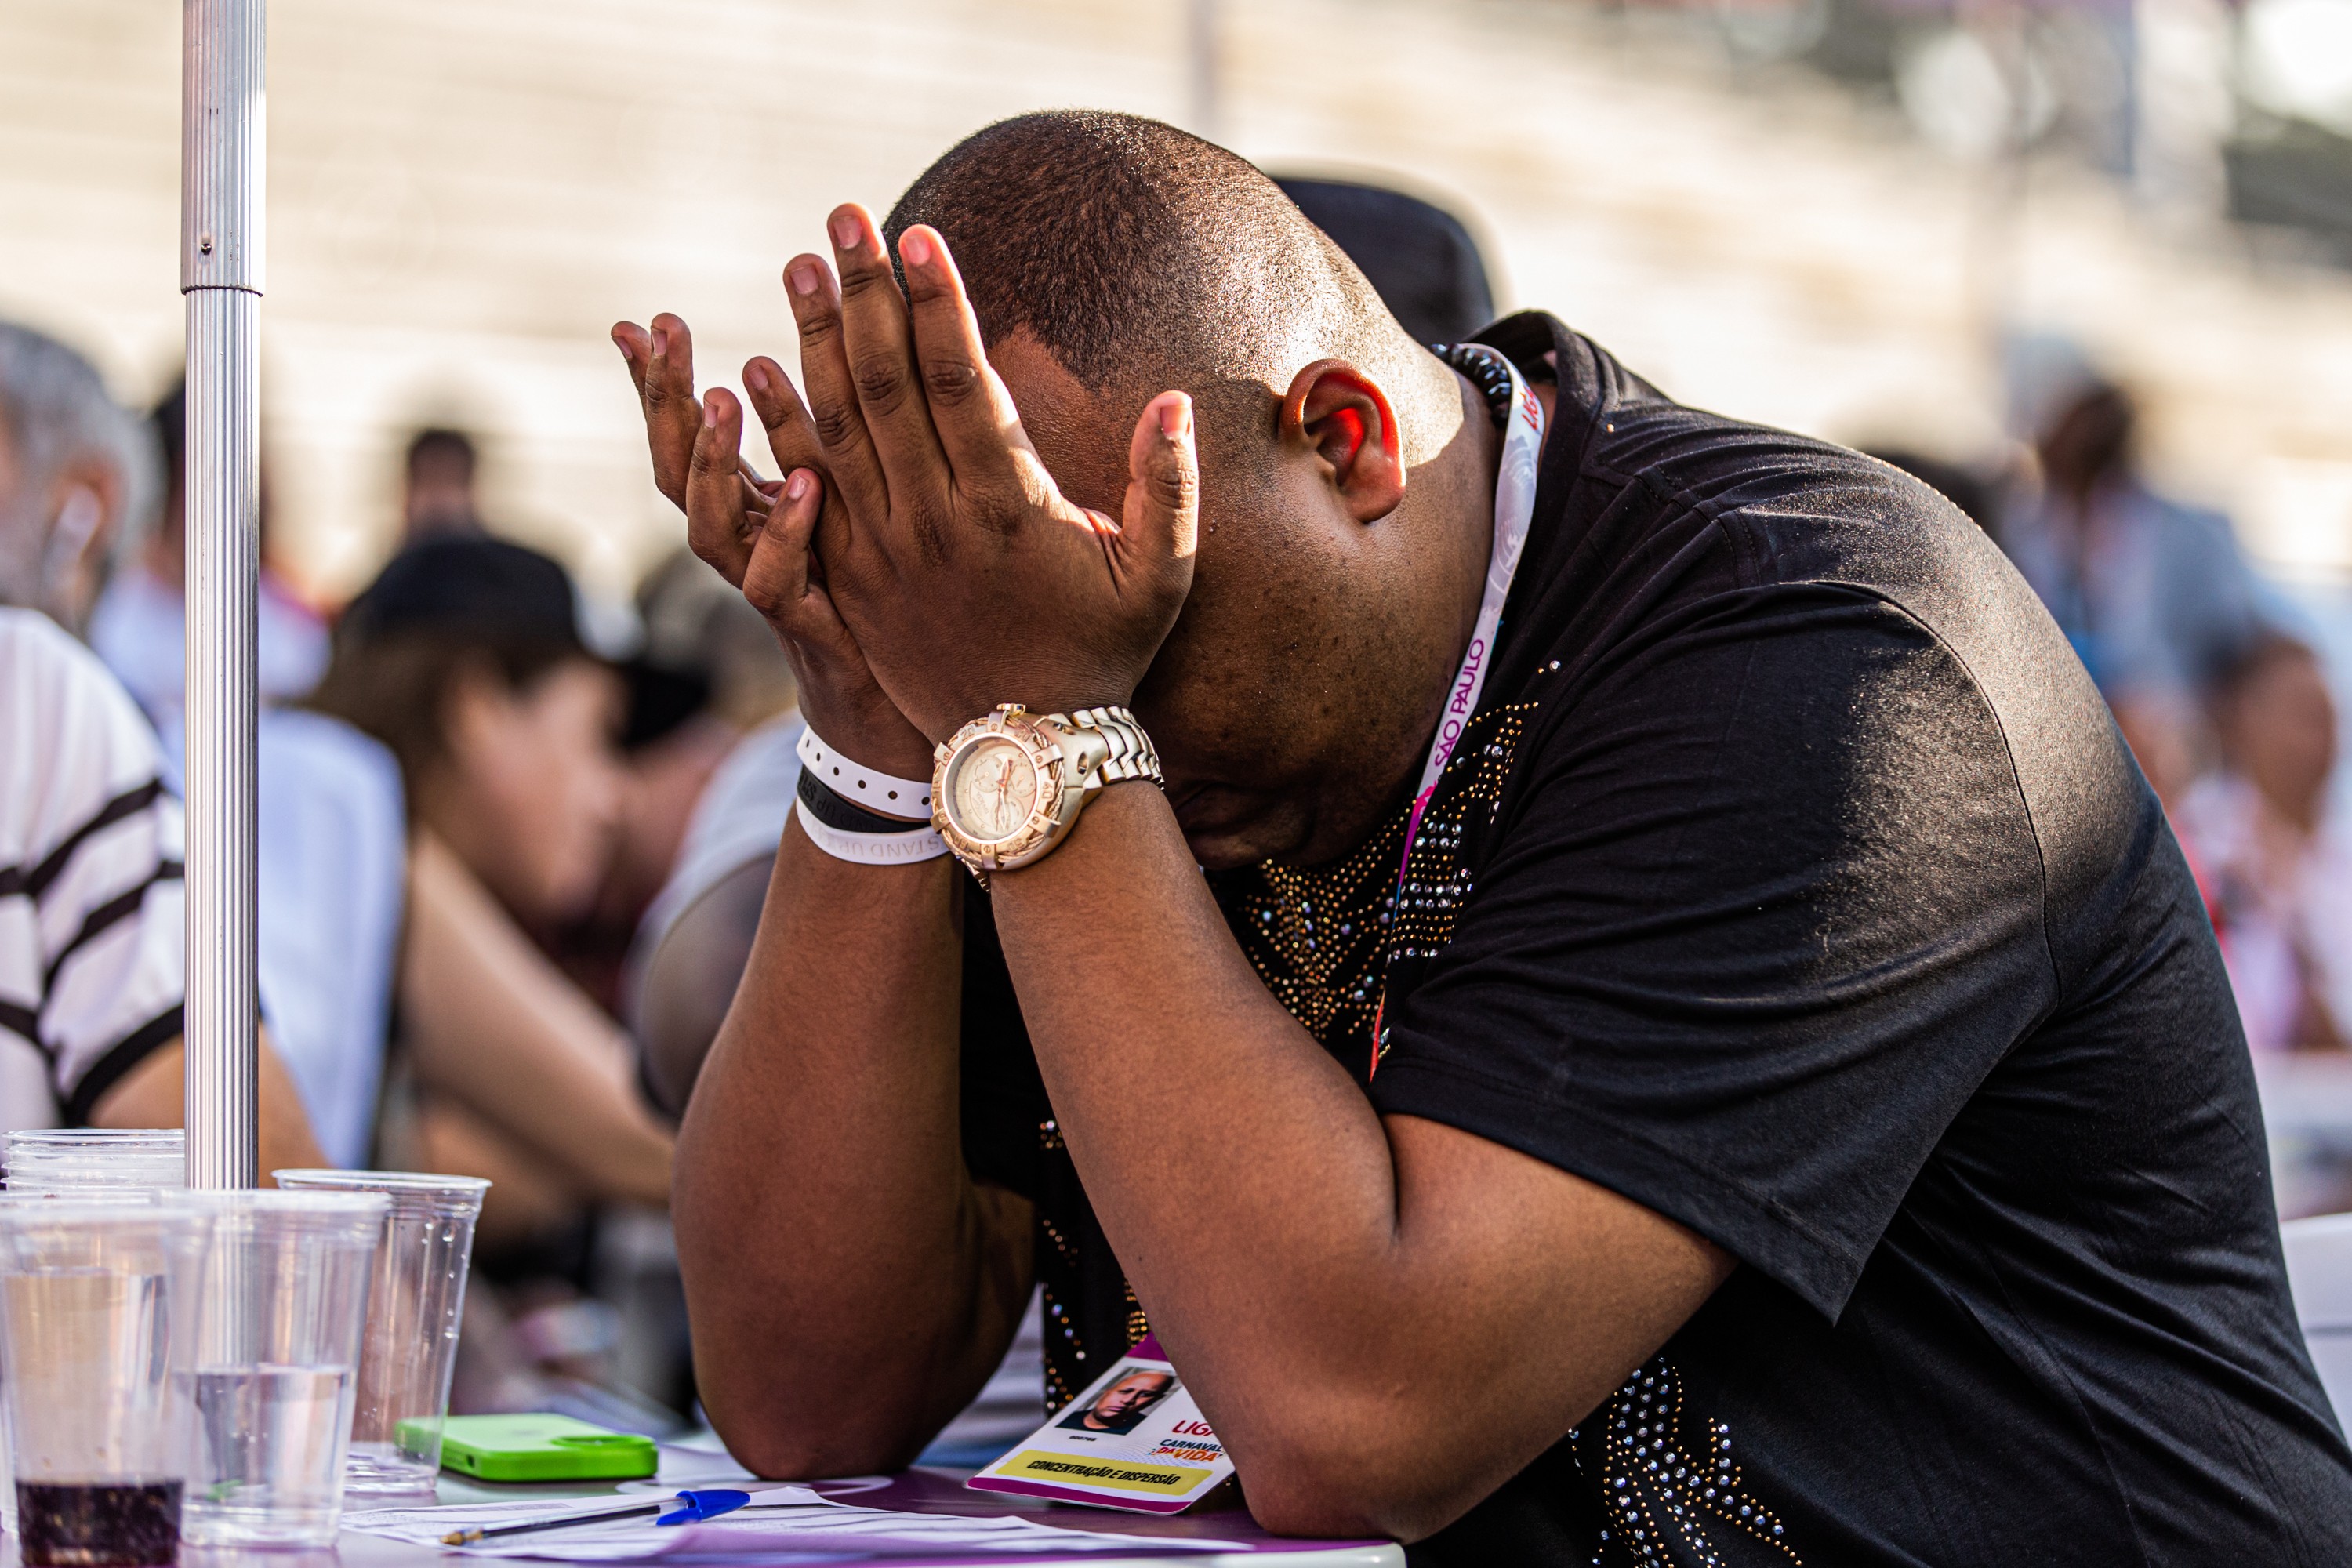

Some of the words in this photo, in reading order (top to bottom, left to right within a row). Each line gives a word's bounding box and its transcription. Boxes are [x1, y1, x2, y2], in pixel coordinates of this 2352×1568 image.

[1434, 719, 1461, 767] SÃO
[1450, 638, 1484, 715] PAULO
[844, 840, 865, 856] UP
[870, 834, 939, 857] STAND
[1160, 1439, 1223, 1452] CARNAVAL
[1174, 1448, 1218, 1461] VIDA
[1026, 1460, 1110, 1477] CONCENTRAÇÃO
[1108, 1470, 1120, 1479] E
[1116, 1471, 1181, 1485] DISPERSÃO
